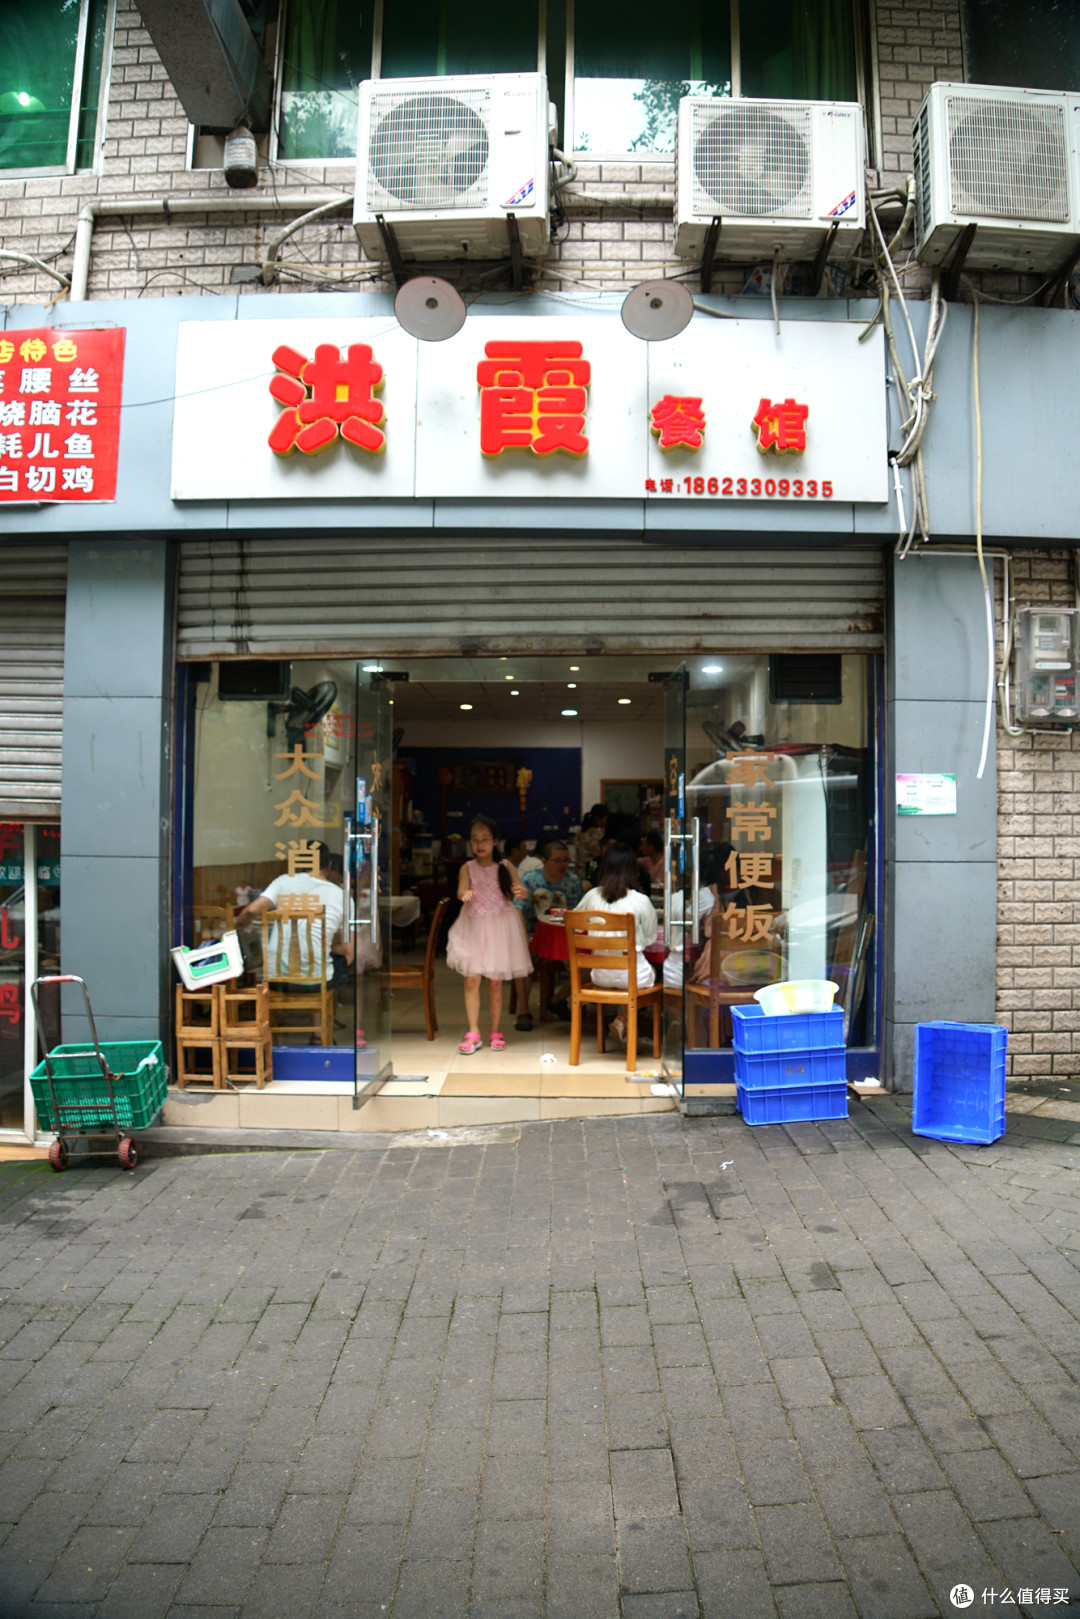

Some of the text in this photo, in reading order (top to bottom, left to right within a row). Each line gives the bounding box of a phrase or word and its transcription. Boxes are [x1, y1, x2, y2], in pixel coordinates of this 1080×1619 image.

[0, 399, 98, 427] 烧脑花
[0, 465, 94, 494] 白切鸡
[723, 748, 777, 943] 家常便饭
[0, 865, 51, 880] 迎临
